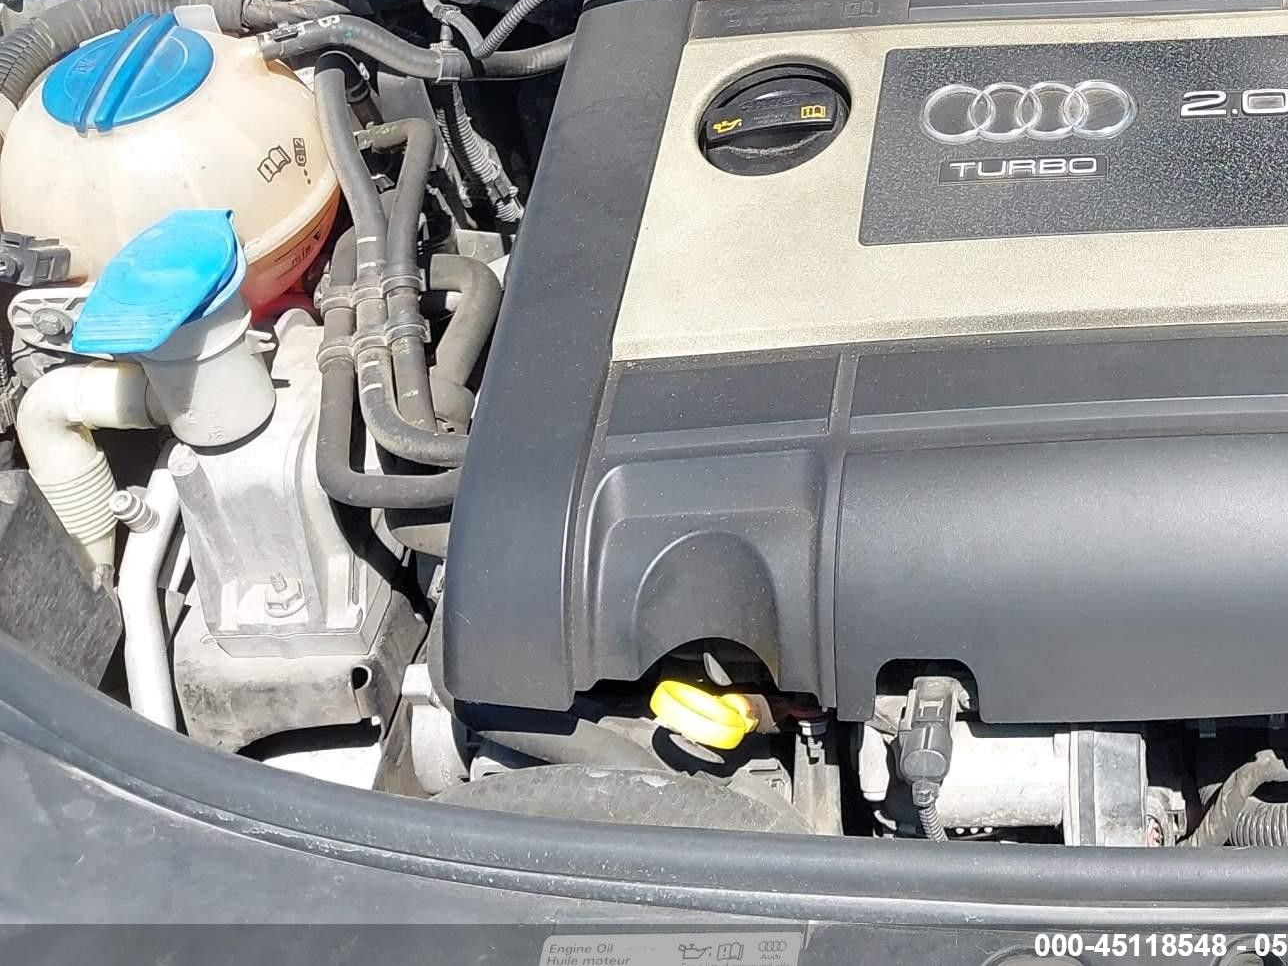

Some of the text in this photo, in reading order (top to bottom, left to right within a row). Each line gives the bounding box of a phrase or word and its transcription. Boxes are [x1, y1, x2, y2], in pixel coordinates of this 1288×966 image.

[294, 138, 306, 164] G12
[949, 157, 1098, 178] TURBO
[549, 944, 592, 955] Engine
[597, 943, 614, 954] Oil
[547, 956, 631, 966] Huile moteur
